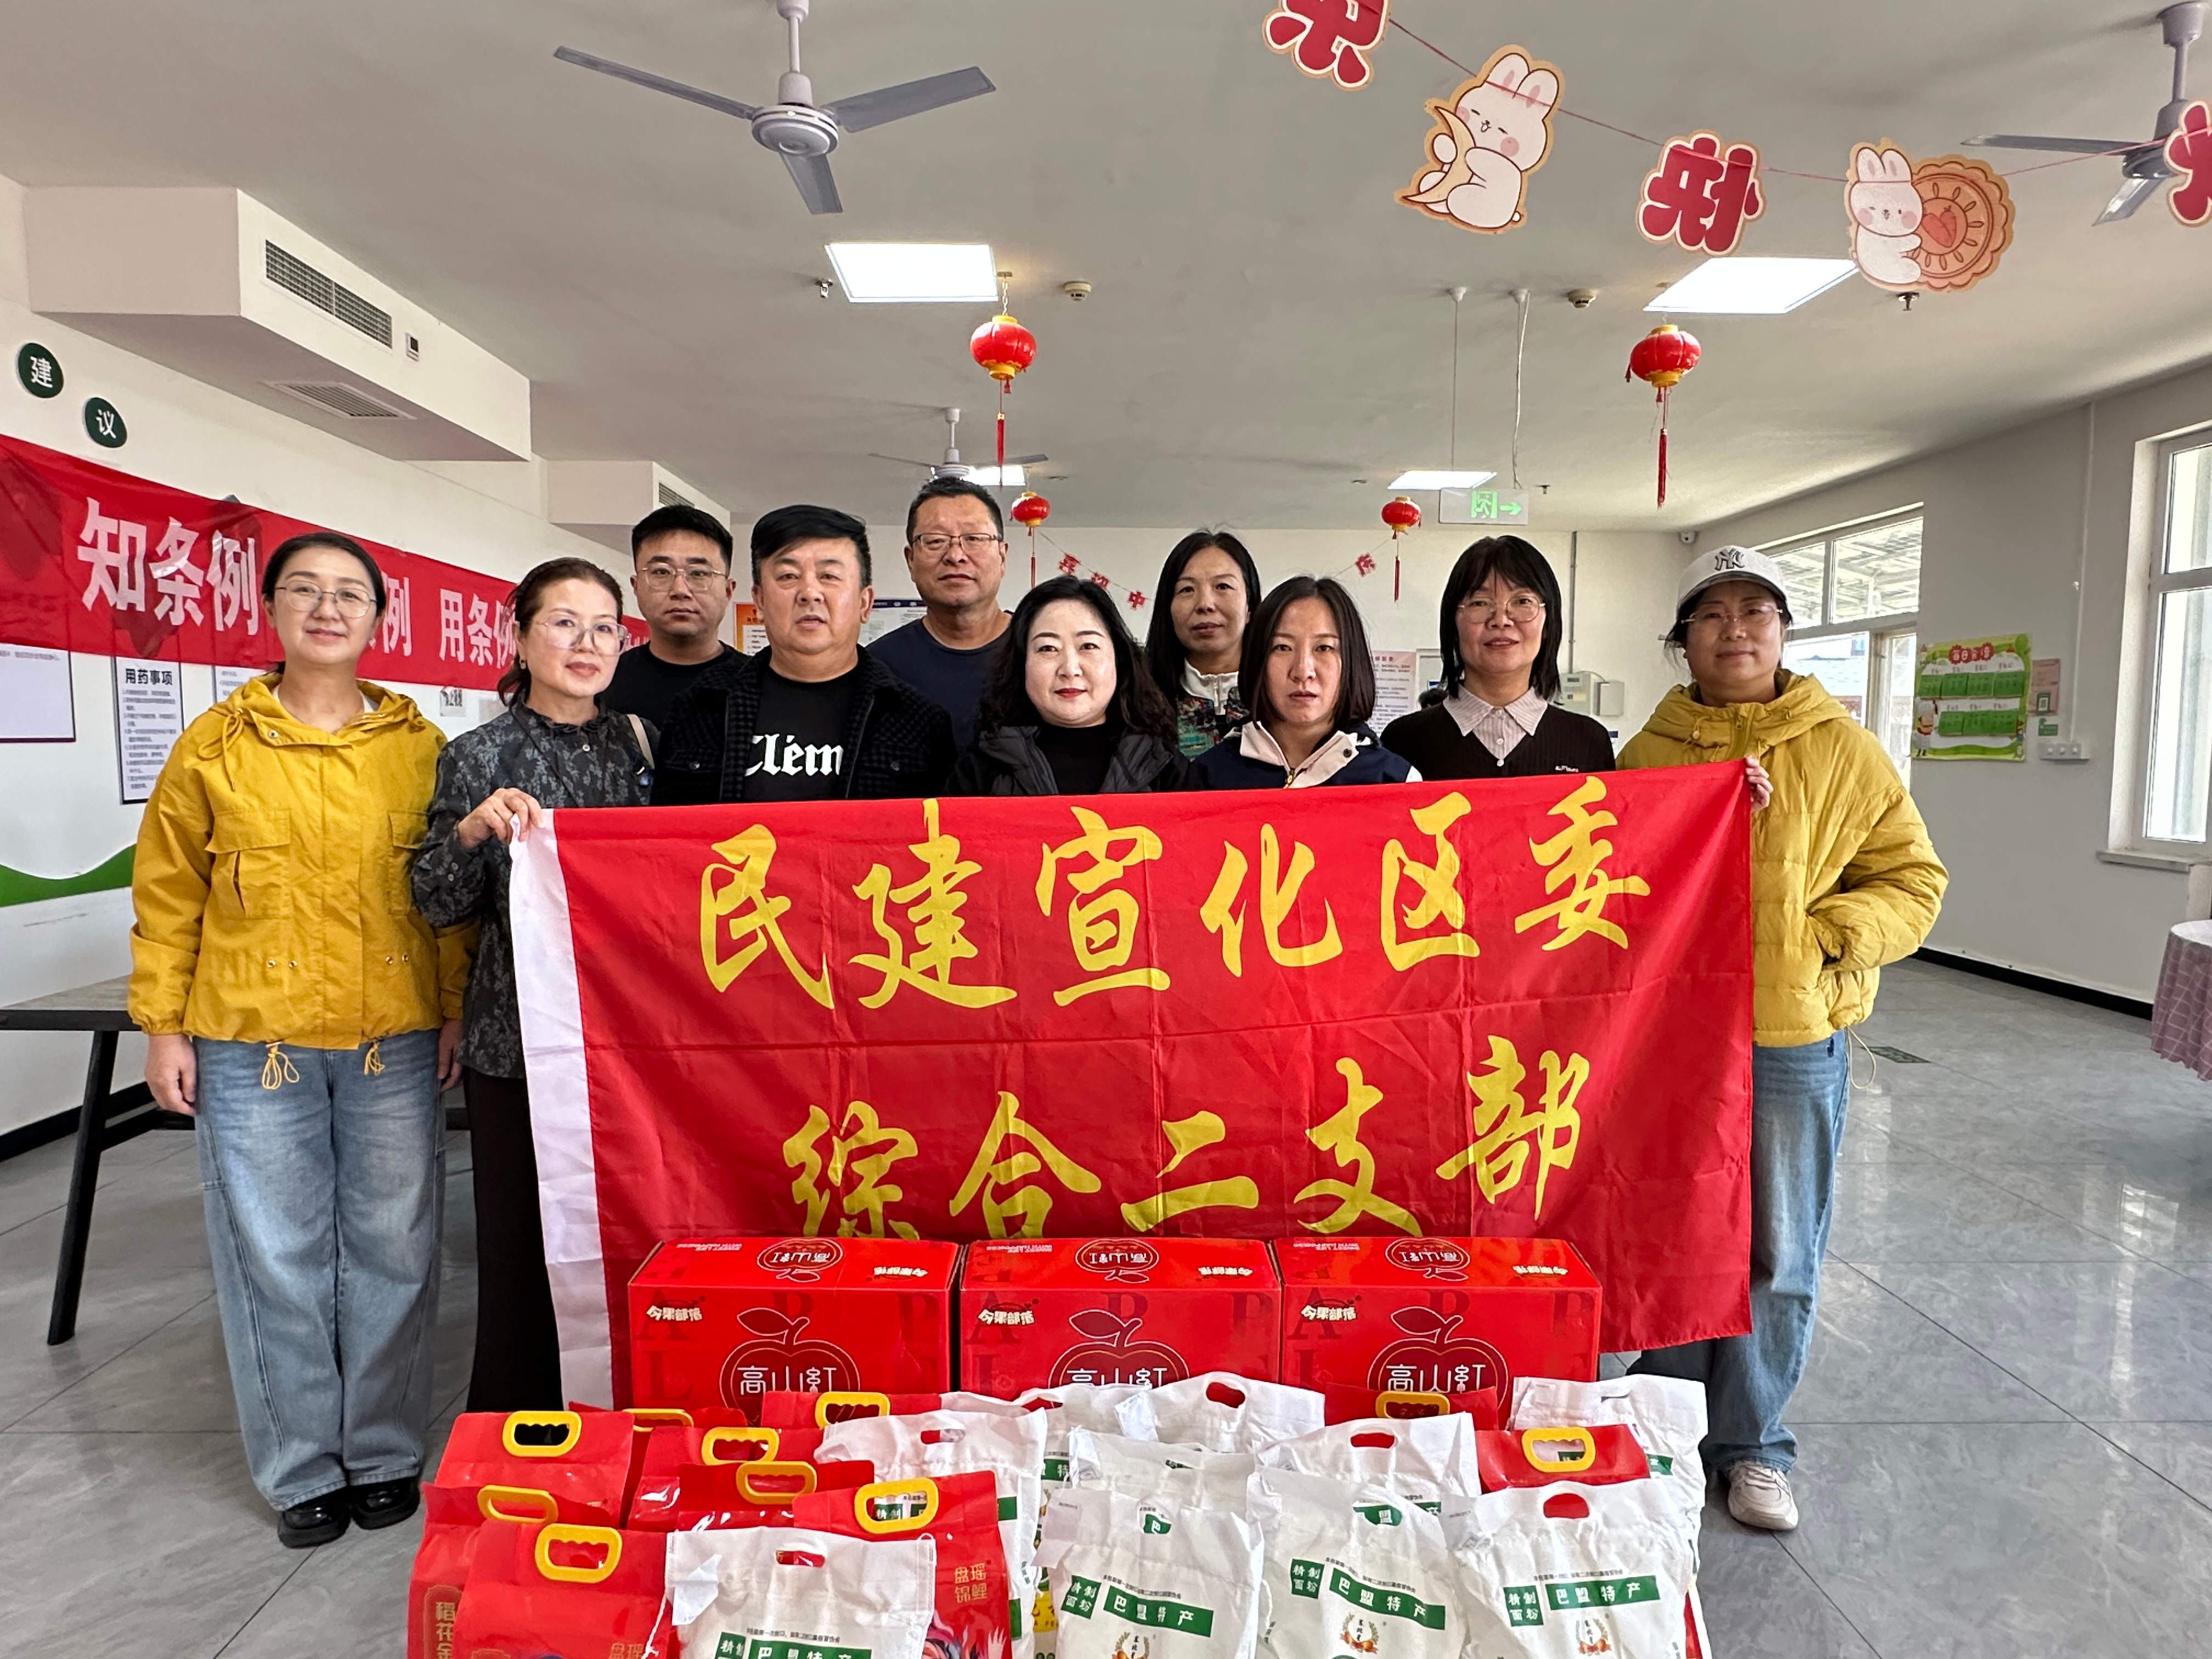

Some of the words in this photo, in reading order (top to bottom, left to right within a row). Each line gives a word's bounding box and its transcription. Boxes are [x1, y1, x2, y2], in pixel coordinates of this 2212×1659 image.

[30, 356, 53, 388] 建
[95, 409, 117, 439] 议
[77, 496, 259, 636] 知条例
[125, 668, 173, 686] 用药事项
[701, 775, 1651, 1009] 民建宣化区委
[783, 1035, 1591, 1240] 综合二支部
[955, 1562, 987, 1584] 盘瑶
[1114, 1594, 1194, 1626] 巴盟特产
[1339, 1577, 1426, 1617] 巴盟特产
[1556, 1582, 1641, 1605] 巴盟特产
